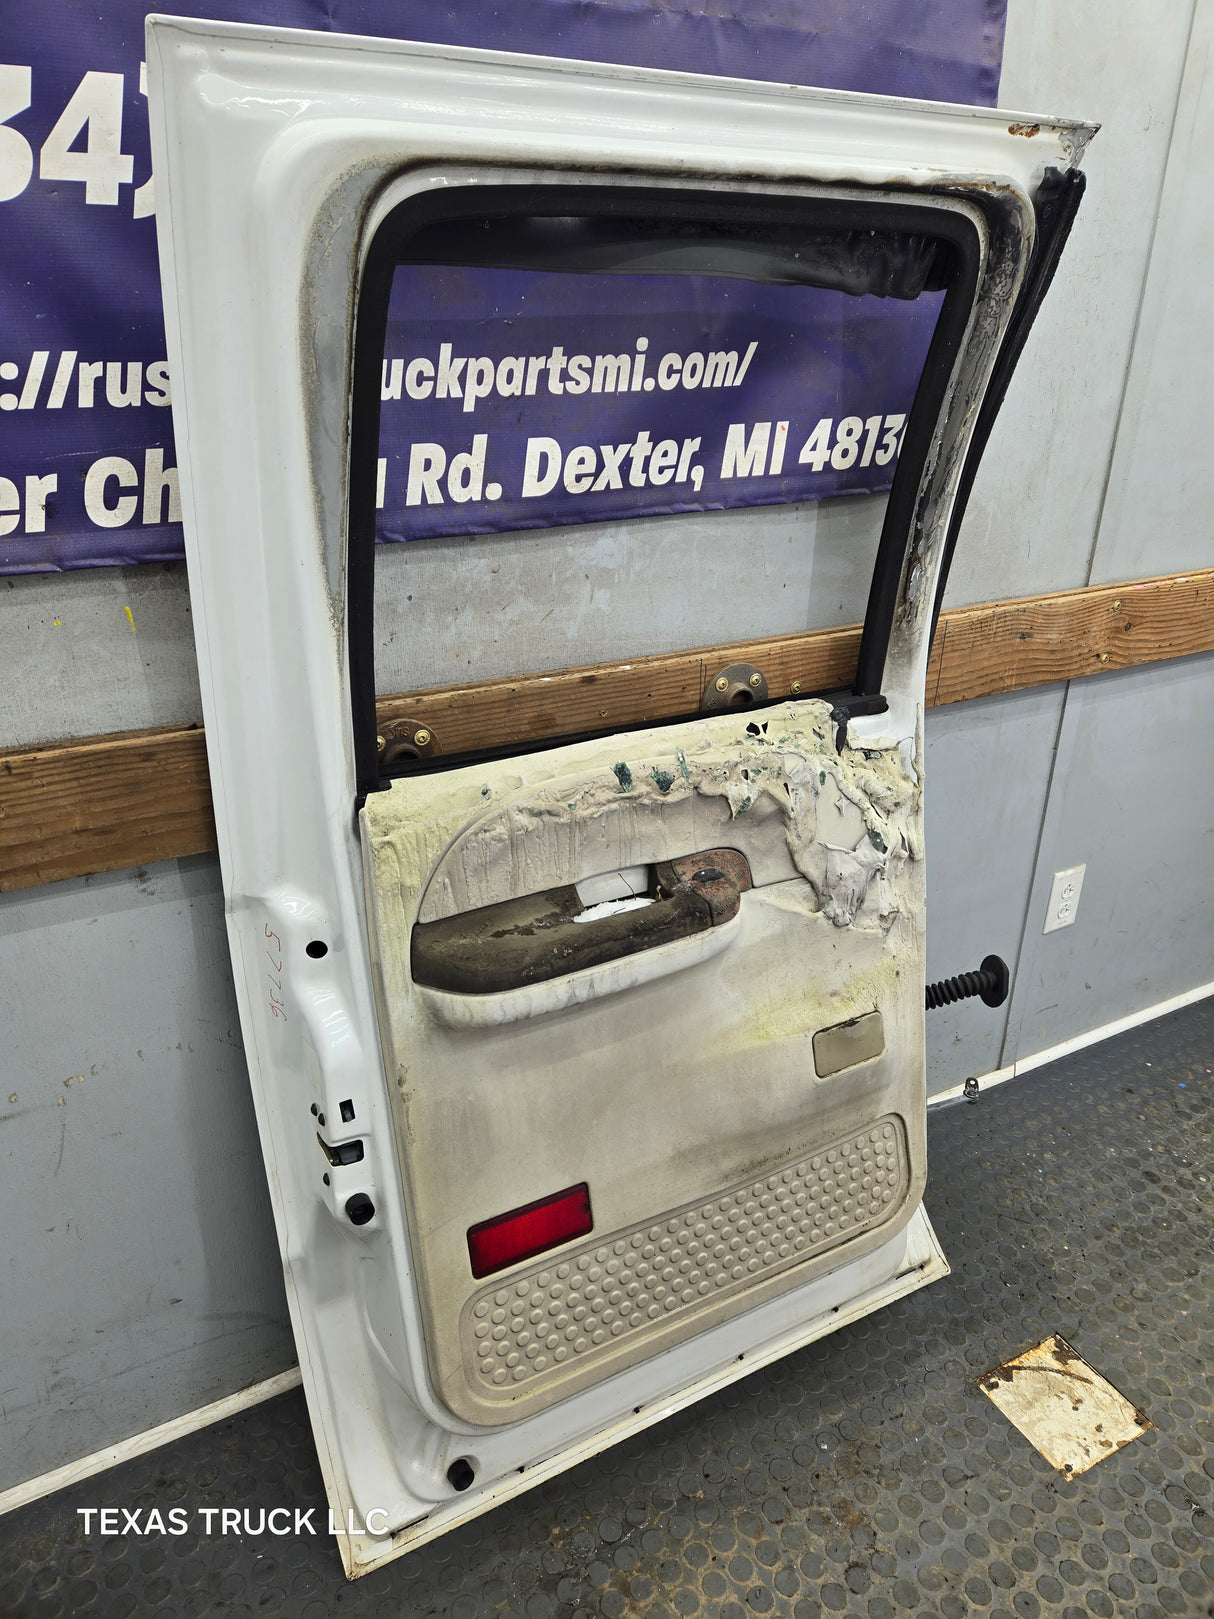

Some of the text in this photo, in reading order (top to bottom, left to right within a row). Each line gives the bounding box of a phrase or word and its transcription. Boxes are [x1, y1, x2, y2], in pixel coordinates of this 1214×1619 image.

[380, 337, 759, 412] uckpartsmi.com/
[84, 448, 183, 528] Ch
[406, 434, 503, 507] Rd.
[522, 431, 705, 498] Dexter,
[720, 421, 789, 479] MI
[799, 413, 908, 472] 4813
